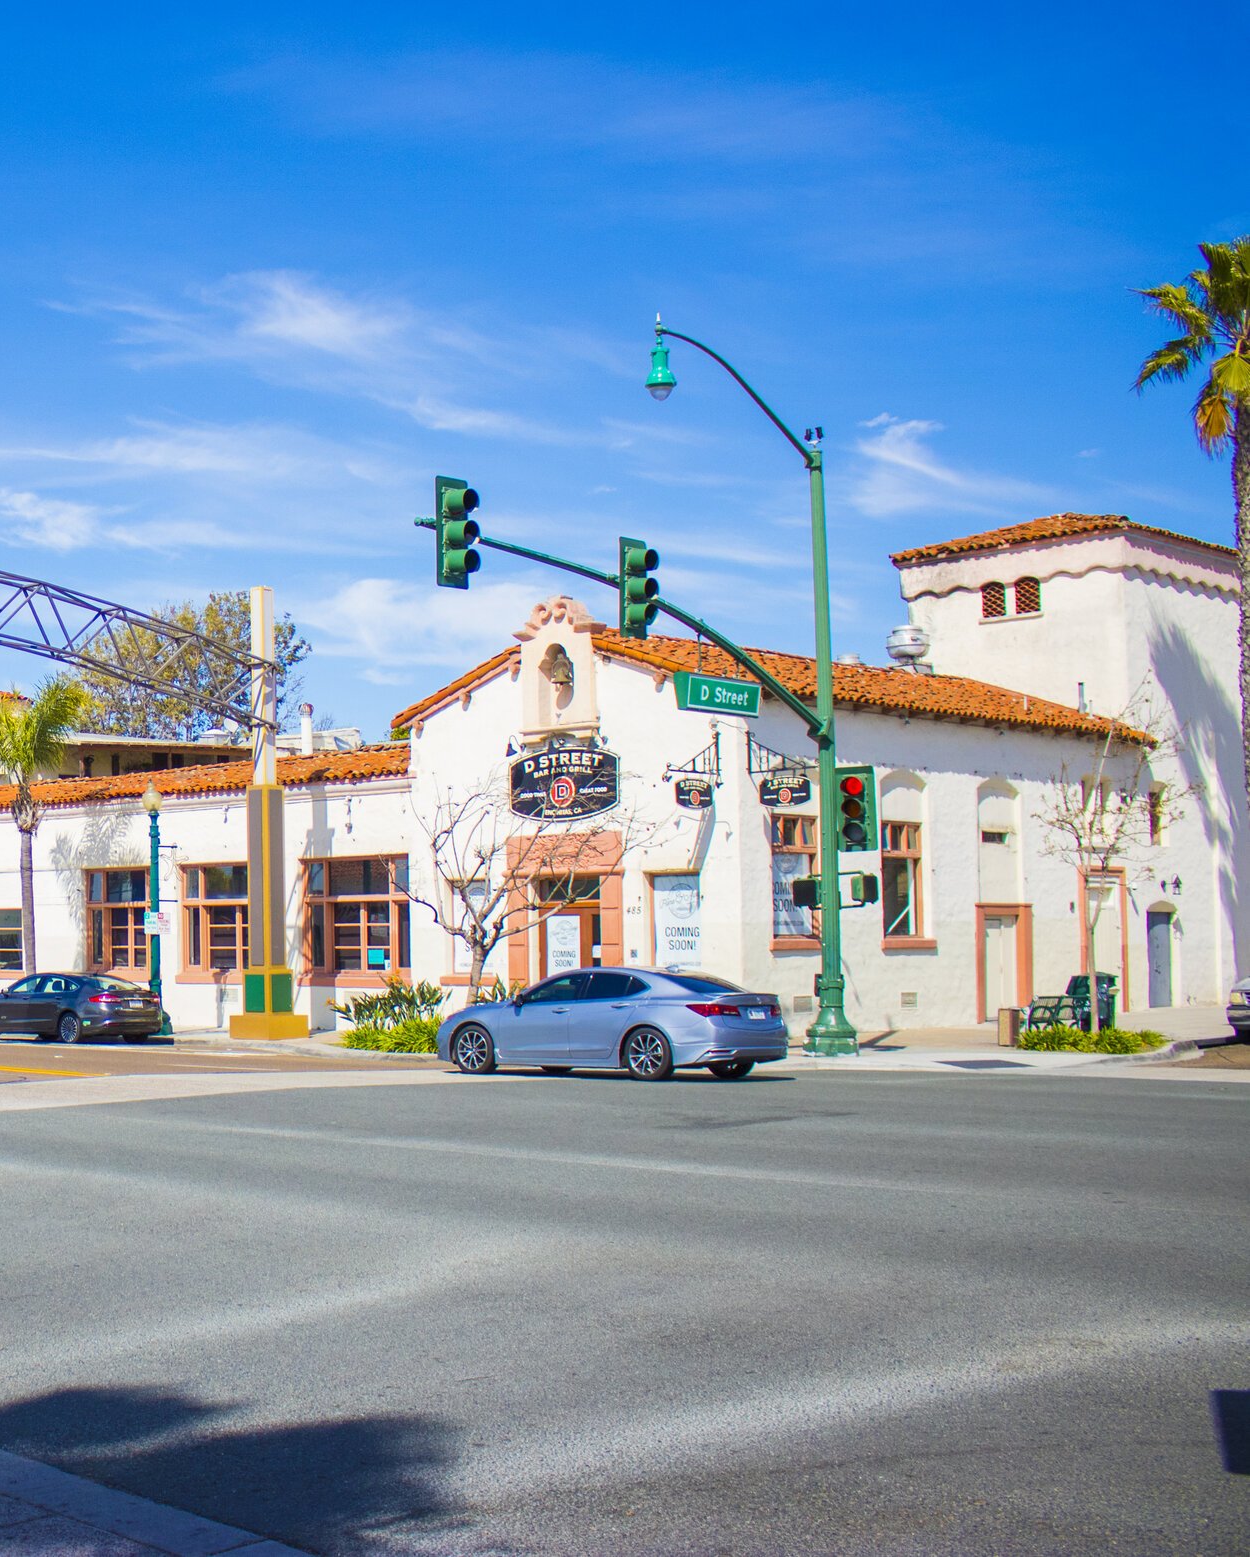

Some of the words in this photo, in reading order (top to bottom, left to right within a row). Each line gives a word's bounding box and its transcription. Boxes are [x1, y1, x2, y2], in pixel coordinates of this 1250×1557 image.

[701, 685, 710, 701] D
[714, 687, 749, 706] Street
[524, 760, 535, 774] D
[539, 752, 604, 769] STREET
[533, 768, 550, 778] BAR
[550, 766, 567, 775] AND
[568, 765, 593, 774] GRILL
[554, 783, 570, 801] D
[626, 906, 642, 915] 485
[664, 926, 701, 938] COMING
[668, 939, 697, 951] SOON!
[552, 950, 576, 958] COMING
[554, 959, 573, 967] SOON!
